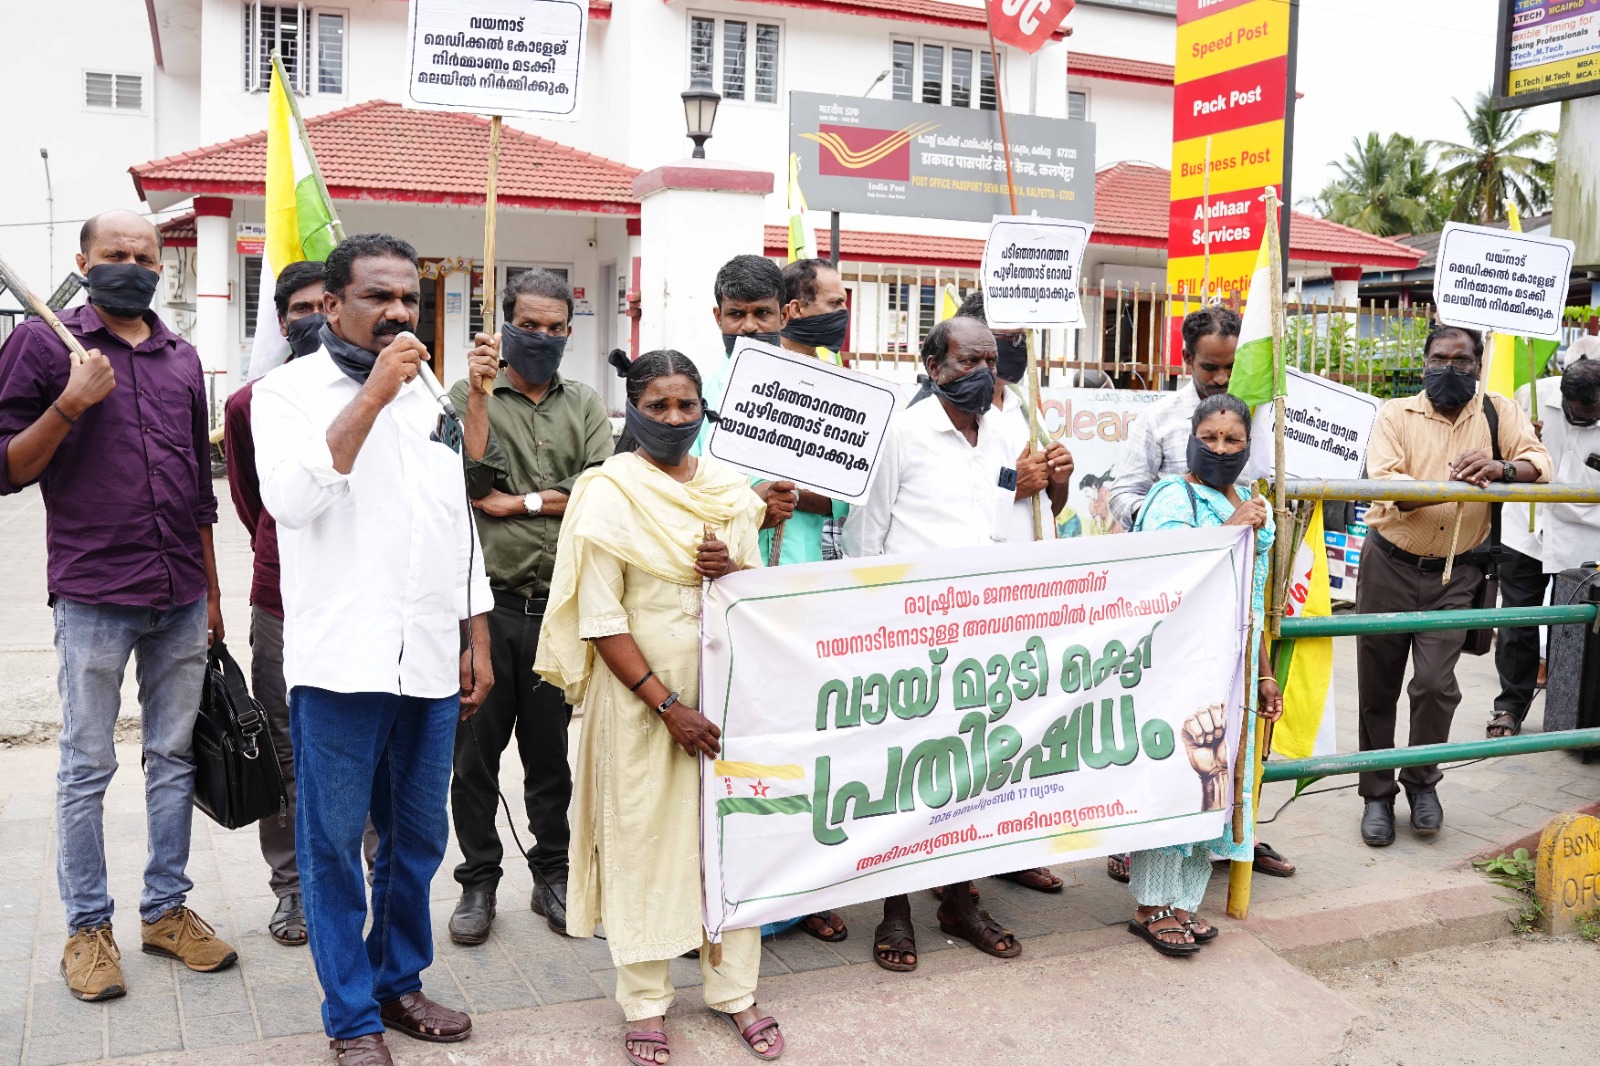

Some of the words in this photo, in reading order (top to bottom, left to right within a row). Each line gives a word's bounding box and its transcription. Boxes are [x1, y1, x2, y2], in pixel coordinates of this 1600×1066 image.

[470, 16, 525, 32] വയനാട്
[1513, 11, 1542, 24] .TECH
[1513, 28, 1540, 41] exible
[1544, 21, 1575, 35] Timing
[1580, 16, 1594, 26] for
[424, 32, 504, 50] മെഡിക്കൽ
[507, 40, 568, 56] കോളേജ്
[1192, 32, 1232, 59] Speed
[1237, 21, 1268, 43] Post
[1511, 41, 1534, 51] orking
[1536, 28, 1588, 46] Professionals
[432, 50, 509, 71] നിർമ്മാണം
[512, 58, 556, 74] മടക്കി
[1511, 51, 1531, 60] .Tech
[1577, 60, 1593, 68] MBA
[418, 70, 476, 87] മലയിൽ
[479, 73, 569, 95] നിർമ്മിക്കുക
[1515, 77, 1540, 88] B.Tech
[1545, 71, 1570, 83] M.Tech
[1576, 70, 1592, 79] MCA
[1193, 94, 1227, 117] Pack
[1230, 85, 1262, 108] Post
[921, 152, 954, 167] डाकघर
[956, 154, 992, 171] पासपोर्ट
[1057, 147, 1076, 159] 673121
[1181, 157, 1236, 177] Business
[1241, 147, 1270, 167] Post
[868, 182, 888, 191] India
[890, 184, 905, 193] Post
[912, 175, 928, 187] POST
[930, 177, 951, 189] OFFICE
[952, 179, 982, 193] PASSPORT
[984, 183, 999, 194] SEVA
[1026, 186, 1055, 199] KALPETTA
[1194, 200, 1251, 221] Aadhaar
[1192, 226, 1251, 246] Services
[1001, 242, 1069, 261] പടിഞ്ഞാറത്തറ
[1485, 252, 1527, 267] വയനാട്
[1046, 265, 1072, 280] റോഡ്
[1201, 274, 1251, 293] ollecti
[1449, 262, 1509, 281] മെഡിക്കൽ
[1511, 272, 1557, 288] കോളേജ്
[1454, 277, 1513, 297] നിർമ്മാണം
[1515, 288, 1545, 302] മടക്കി
[1443, 293, 1487, 309] മലയിൽ
[1489, 298, 1554, 320] നിർമ്മിക്കുക
[751, 380, 867, 425] പടിഞ്ഞാറത്തറ
[823, 423, 869, 448] റോഡ്
[1284, 407, 1330, 432] ാത്രികാല
[1330, 423, 1358, 442] യാത്ര
[1271, 421, 1319, 448] രോധനം
[1320, 437, 1358, 462] നീക്കുക
[904, 586, 979, 616] രാഷ്ട്രീയം
[983, 570, 1109, 605] ജനസേവനത്തിന്
[815, 622, 960, 659] വയനാടിനോടുള്ള
[963, 603, 1086, 638] അവഗണനയിൽ
[815, 647, 948, 731] വായ്
[952, 635, 1049, 723] മൂടി
[812, 694, 1175, 847] പ്രതിഷേധം
[929, 811, 951, 825] 2026
[1018, 788, 1028, 800] 17
[1030, 783, 1064, 799] വ്യാഴം
